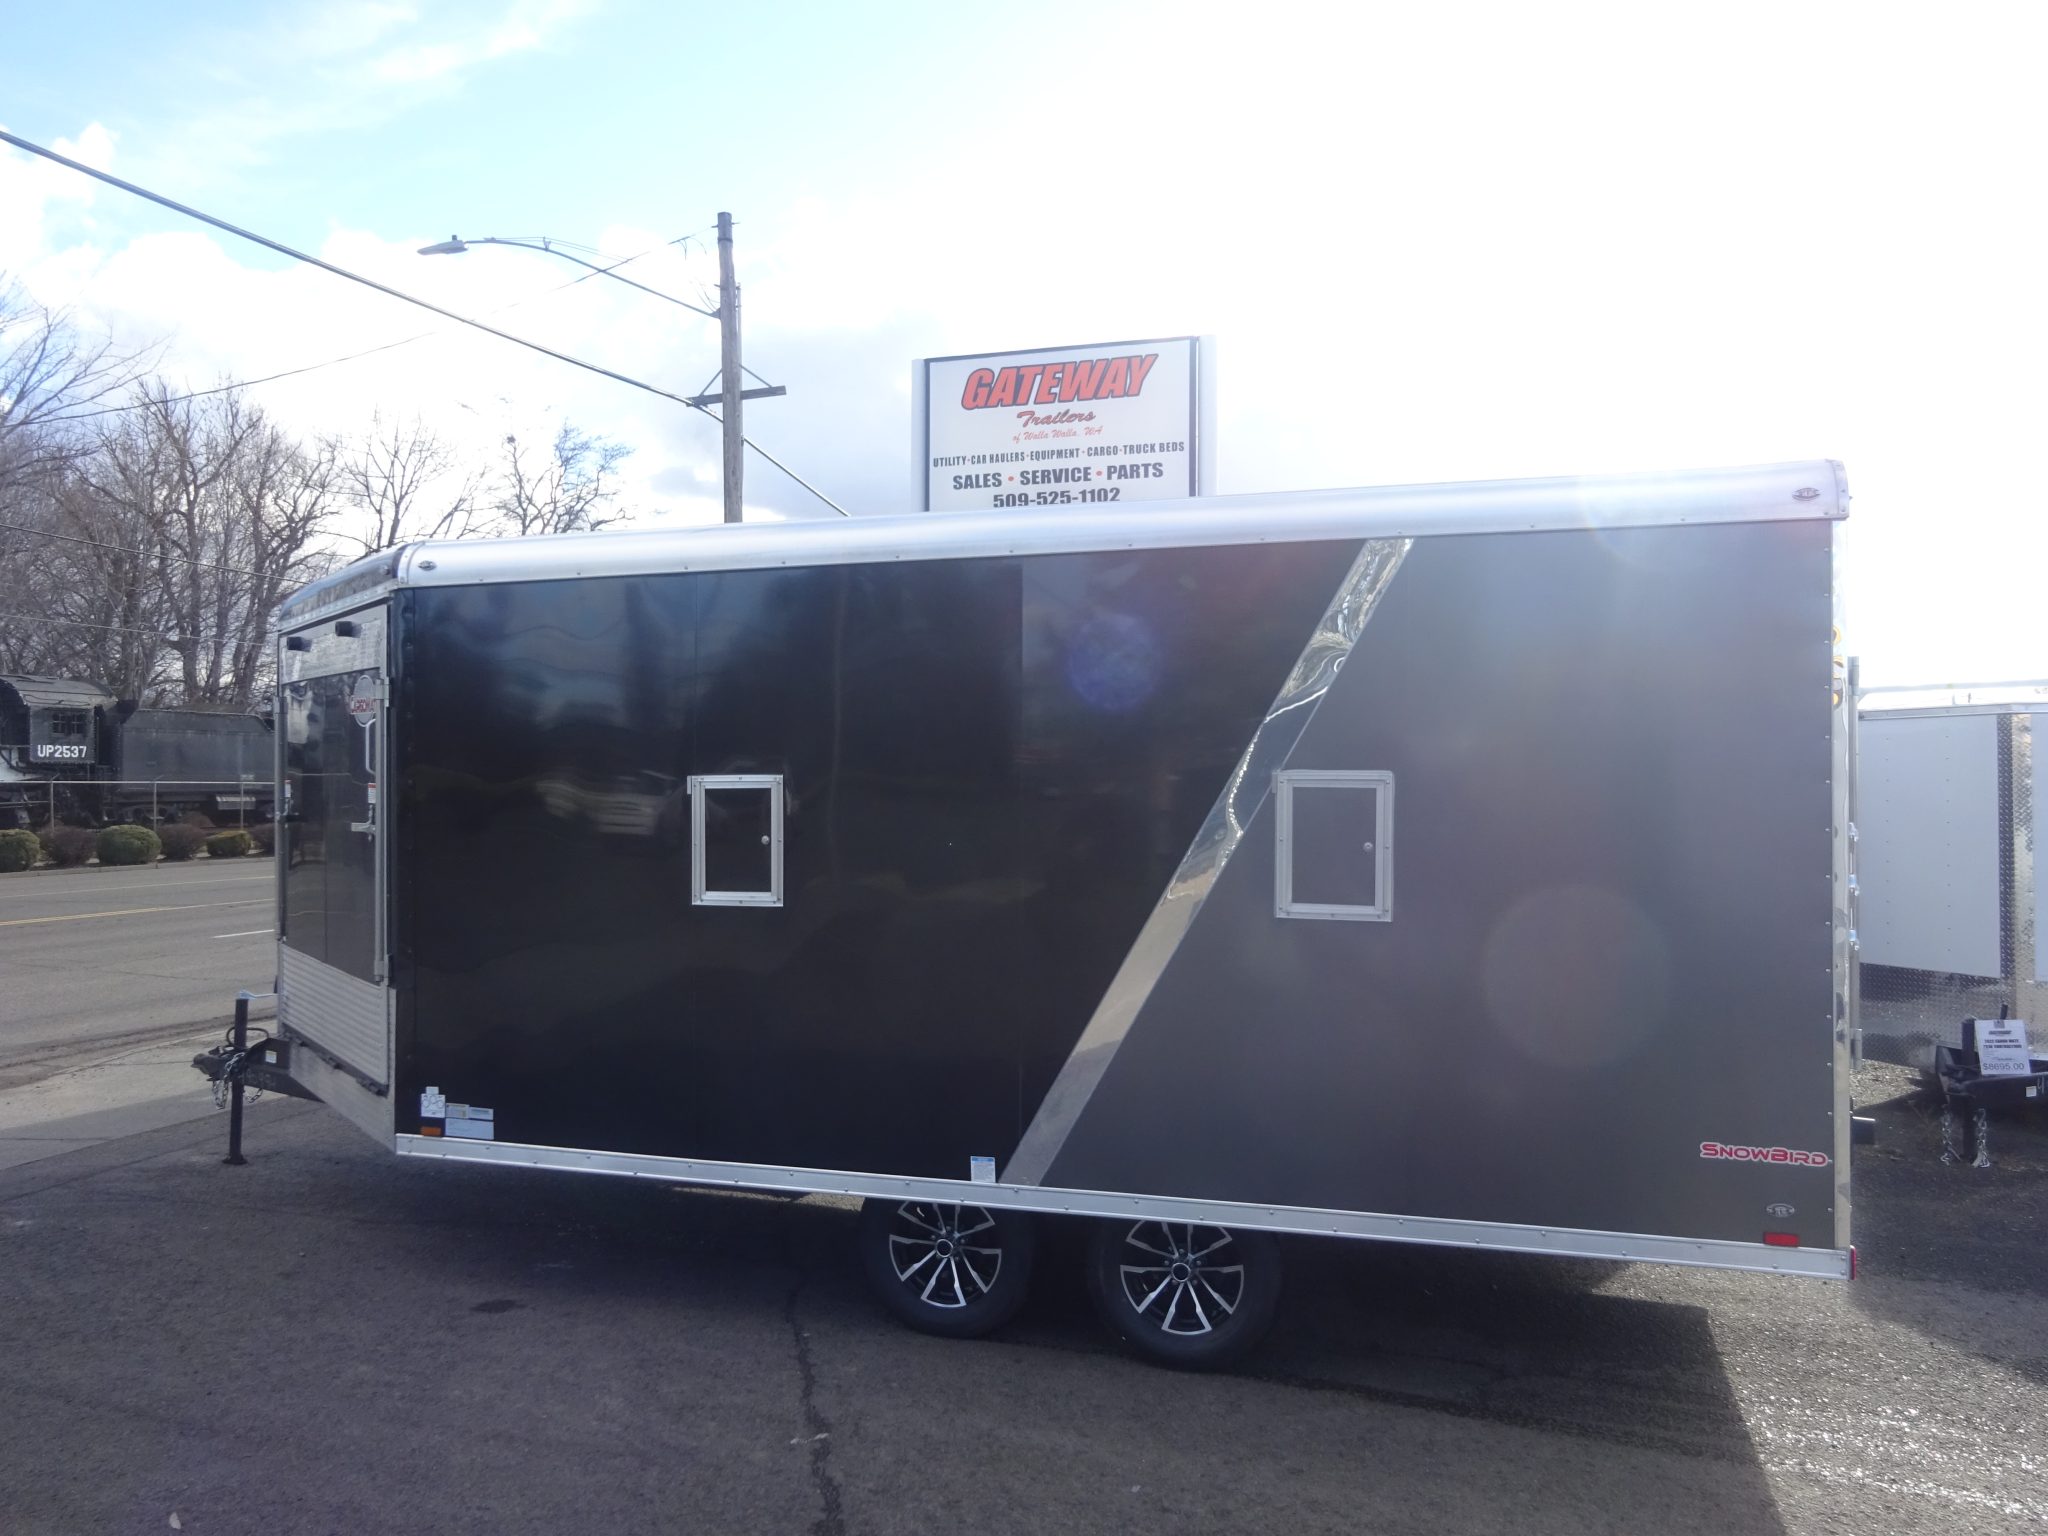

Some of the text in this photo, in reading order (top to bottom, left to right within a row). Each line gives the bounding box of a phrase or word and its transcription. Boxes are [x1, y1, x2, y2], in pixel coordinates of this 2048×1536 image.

[960, 353, 1159, 411] GATEWAY
[1016, 408, 1096, 428] Trailers
[1012, 432, 1021, 444] of
[1023, 431, 1049, 440] Walla
[1084, 425, 1104, 436] WA
[933, 441, 1185, 468] UTILITY CAR HAULERS EQUIPMENT CARGO TRUCK BEDS
[953, 462, 1164, 490] SALES SERVICE PARTS
[993, 487, 1121, 508] 509-525-1102
[37, 744, 87, 758] UP2537
[1700, 1141, 1828, 1167] SNOWBIRD
